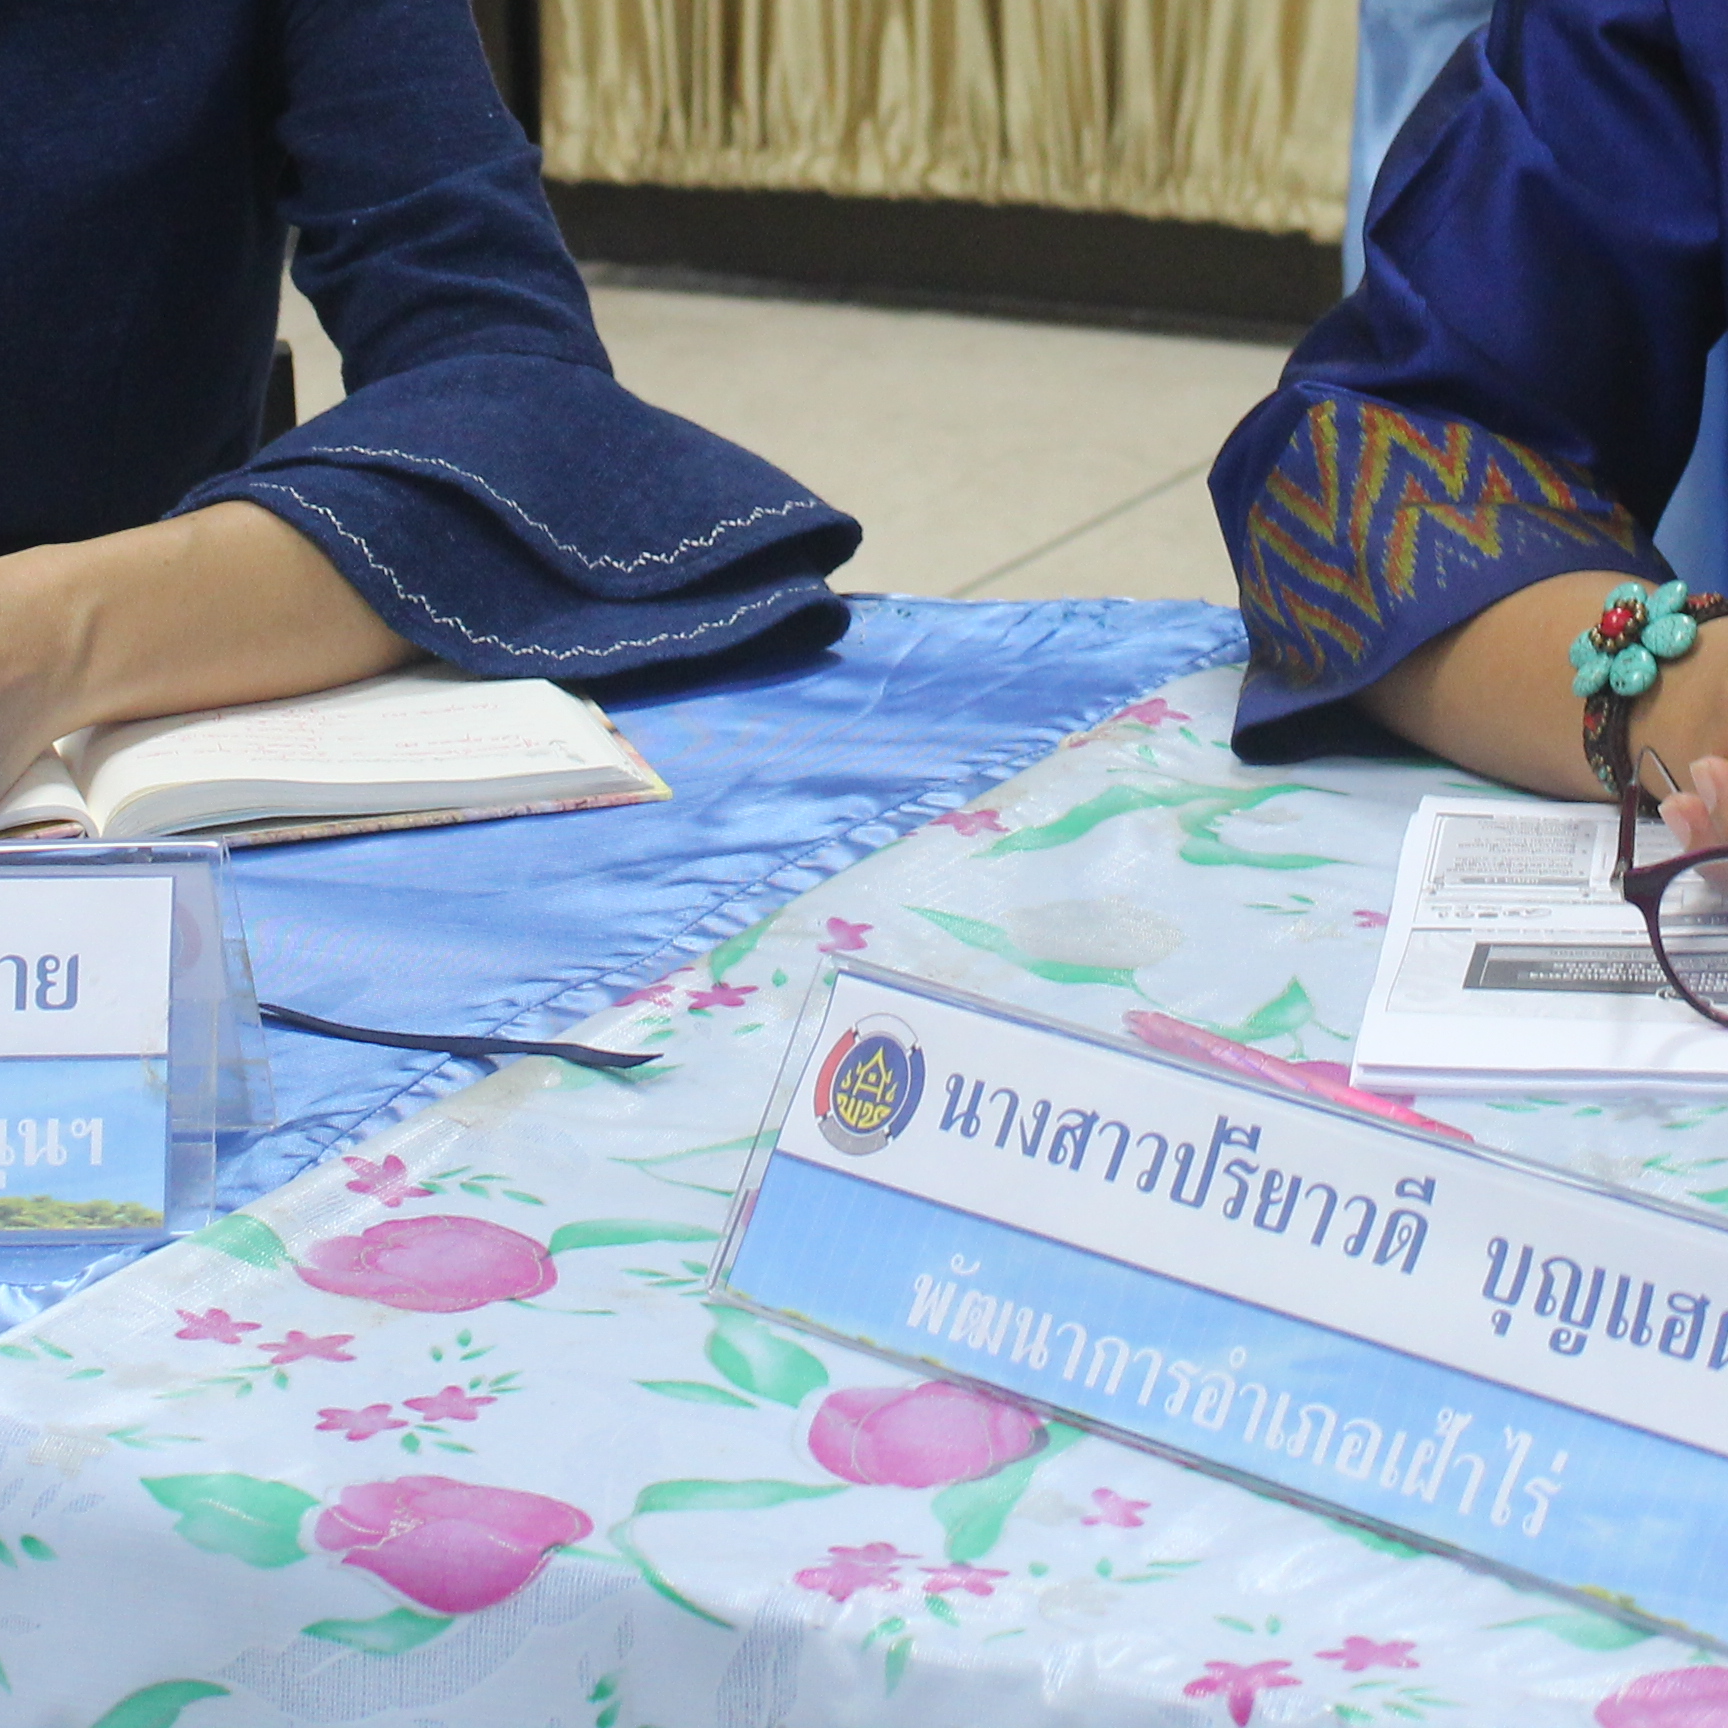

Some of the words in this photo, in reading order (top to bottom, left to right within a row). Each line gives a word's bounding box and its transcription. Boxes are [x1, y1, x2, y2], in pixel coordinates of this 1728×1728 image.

[938, 1073, 1437, 1275] นางสาวปรียาวดี
[905, 1253, 1570, 1538] พัฒนาการอำเภอเฝ้าไร่
